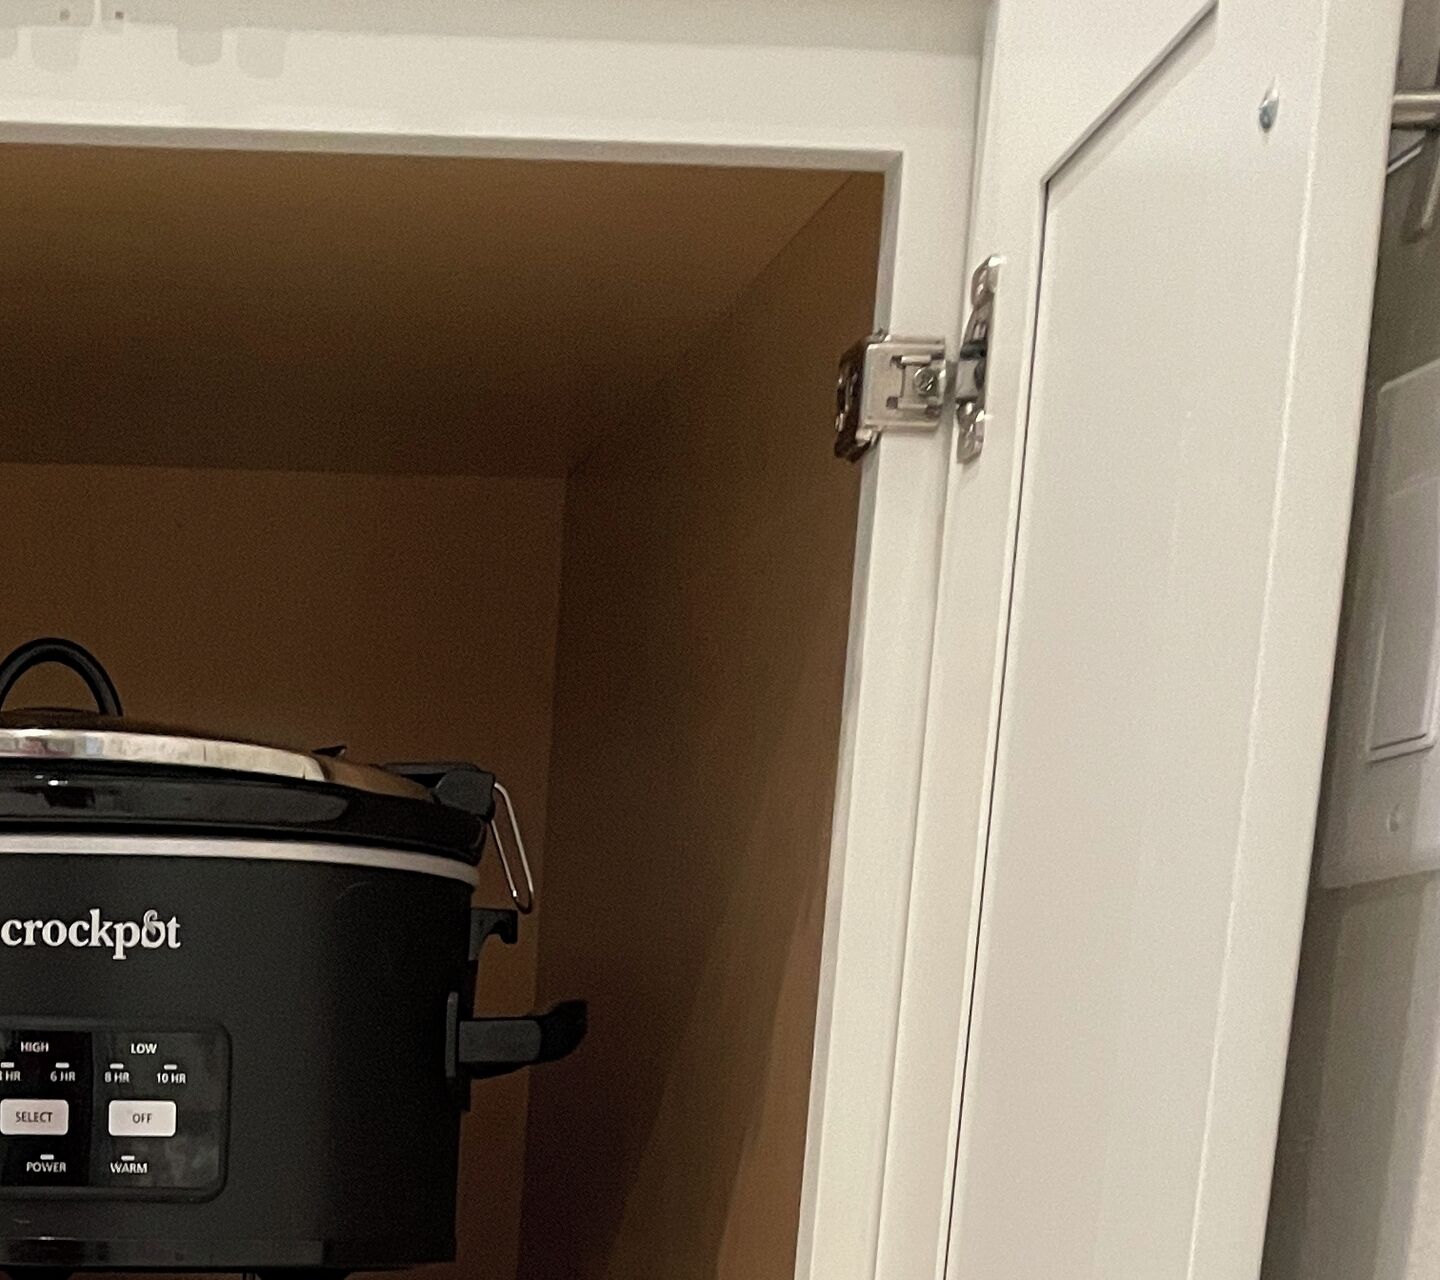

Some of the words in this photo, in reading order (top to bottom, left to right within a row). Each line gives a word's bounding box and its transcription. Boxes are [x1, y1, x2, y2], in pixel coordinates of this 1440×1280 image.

[0, 908, 181, 960] crockpot
[20, 1041, 50, 1053] HIGH
[130, 1043, 158, 1055] LOW
[5, 1071, 21, 1082] HR
[50, 1071, 57, 1082] 6
[113, 1073, 130, 1083] HR
[156, 1073, 169, 1083] 10
[171, 1074, 187, 1084] HR
[15, 1111, 53, 1123] SELECT
[132, 1113, 153, 1124] OFF
[26, 1161, 67, 1173] POWER
[110, 1162, 148, 1174] WARM
